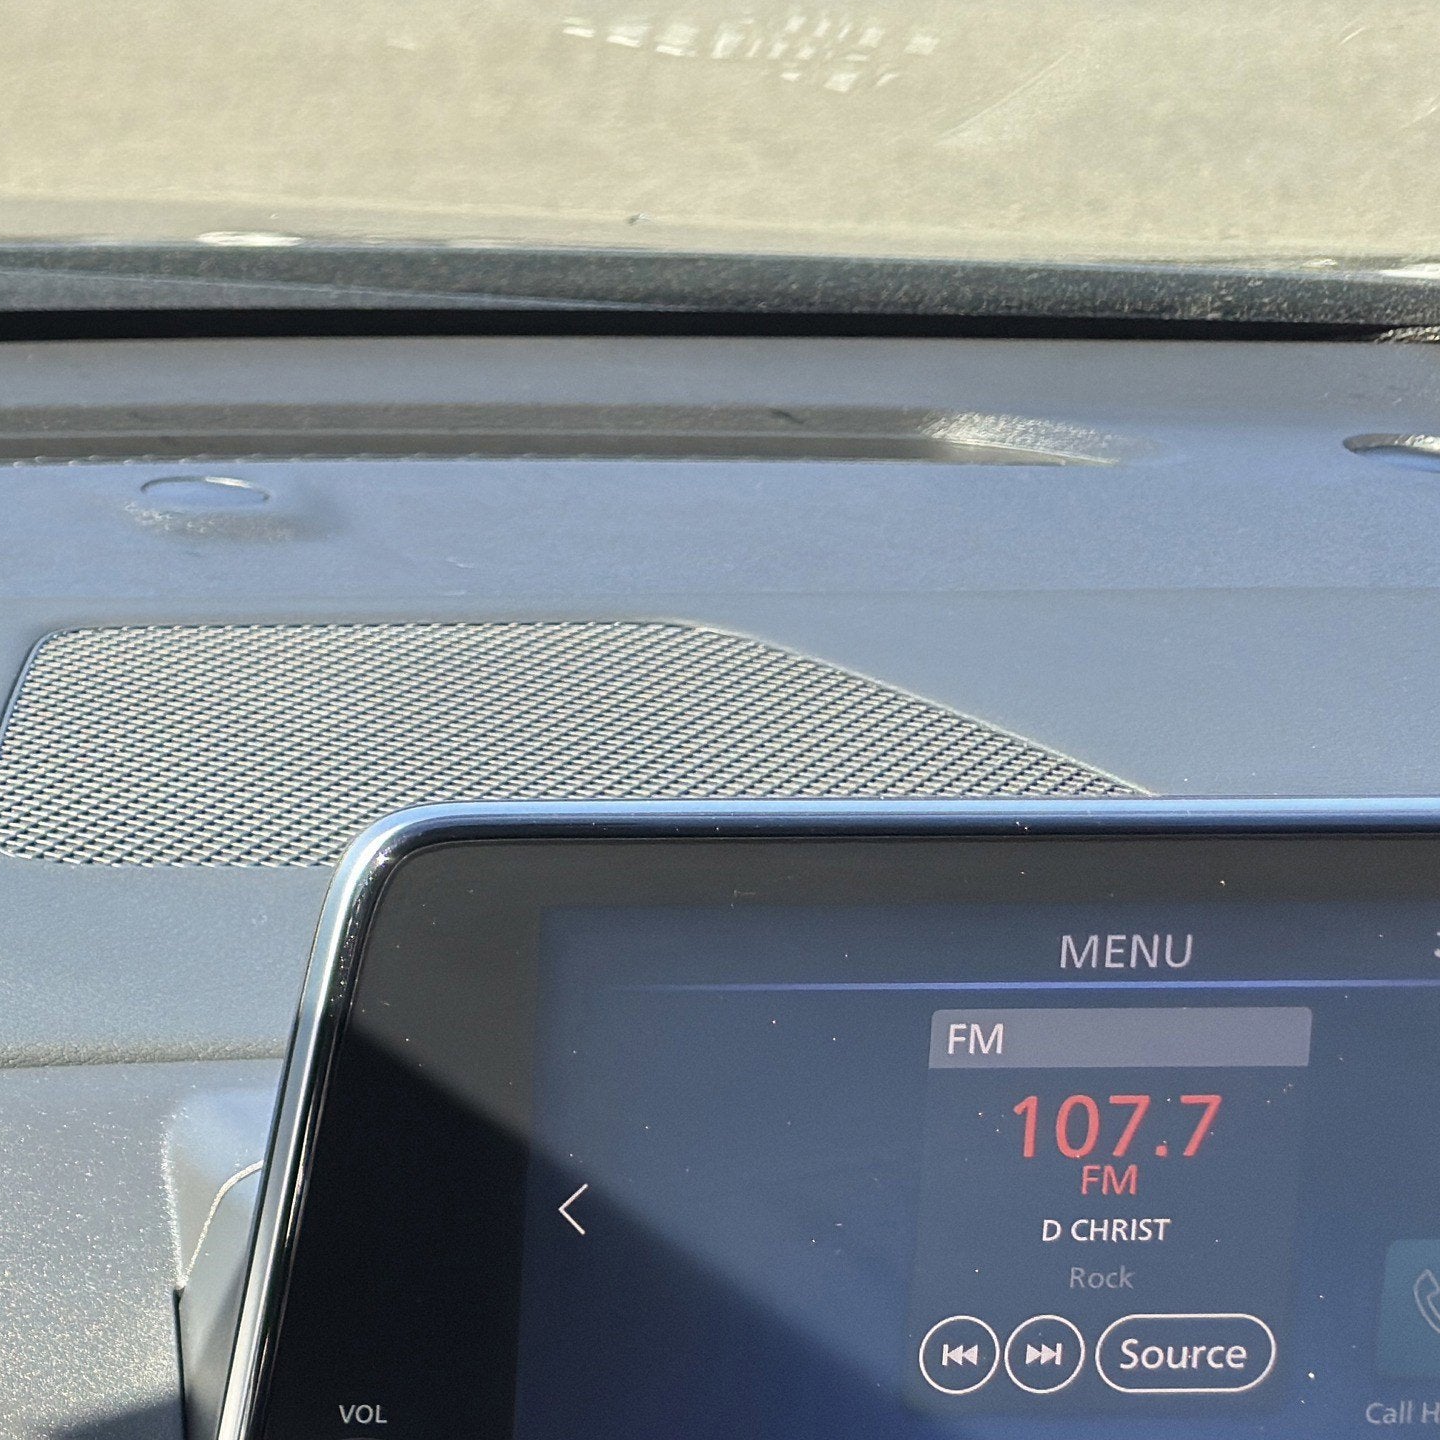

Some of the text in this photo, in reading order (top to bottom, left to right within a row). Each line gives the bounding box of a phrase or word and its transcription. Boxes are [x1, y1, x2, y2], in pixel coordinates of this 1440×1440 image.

[1060, 933, 1193, 968] MENU
[947, 1023, 1004, 1054] FM
[1012, 1093, 1223, 1159] 107.7
[1082, 1164, 1138, 1195] FM
[1042, 1218, 1171, 1242] D CHRIST
[1069, 1265, 1134, 1289] Rock
[1120, 1338, 1247, 1371] Source
[338, 1404, 388, 1424] VOL
[1365, 1400, 1412, 1424] Call
